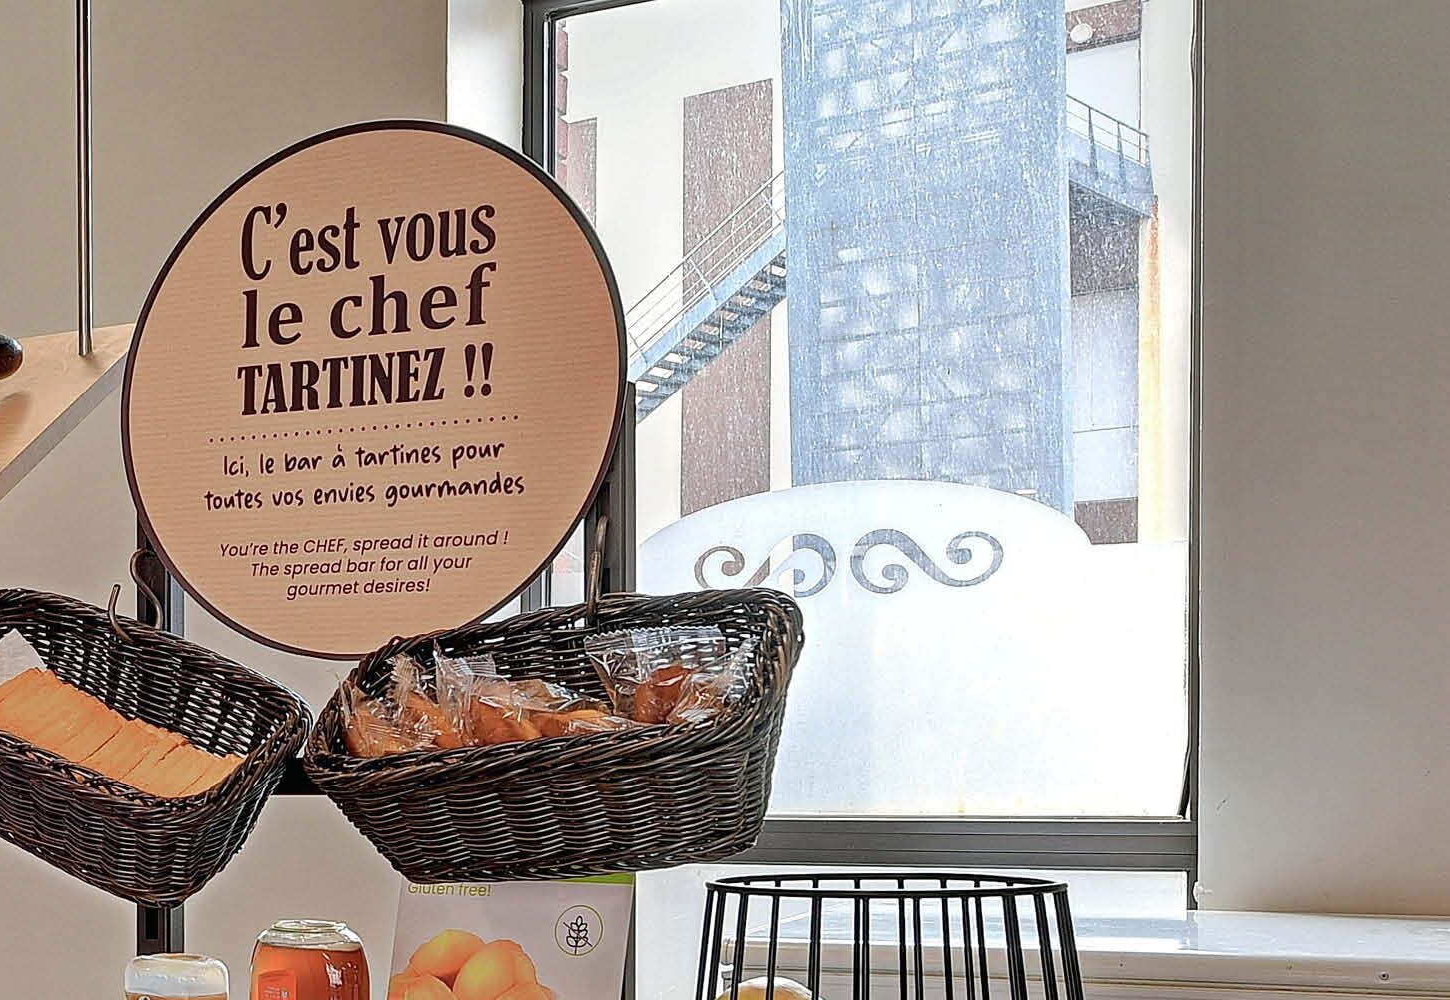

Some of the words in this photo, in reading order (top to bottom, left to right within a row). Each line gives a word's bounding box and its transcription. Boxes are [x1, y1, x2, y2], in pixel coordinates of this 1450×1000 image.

[241, 203, 360, 280] C'est
[378, 204, 497, 264] vous
[241, 290, 303, 348] le
[330, 262, 497, 339] chef
[237, 347, 446, 415] TARTINEZ
[464, 342, 494, 398] !!
[223, 456, 249, 477] Ici,
[260, 454, 274, 474] le
[285, 453, 322, 473] bar
[332, 445, 346, 468] à
[355, 444, 441, 469] tartines
[452, 442, 505, 468] pour
[204, 488, 263, 511] toutes
[272, 489, 304, 507] vos
[313, 483, 375, 505] envies
[385, 472, 525, 507] gourmandes
[219, 542, 269, 557] You're
[273, 540, 299, 555] the
[303, 538, 348, 555] CHEF,
[352, 534, 412, 555] spread
[417, 534, 429, 549] it
[433, 531, 497, 549] around
[250, 563, 279, 577] The
[283, 560, 342, 579] spread
[346, 558, 377, 574] bar
[379, 557, 403, 573] for
[407, 556, 428, 571] all
[433, 555, 472, 574] your
[286, 580, 358, 600] gourmet
[363, 578, 430, 595] desires!
[408, 884, 455, 894] Gluten
[459, 883, 492, 896] free!
